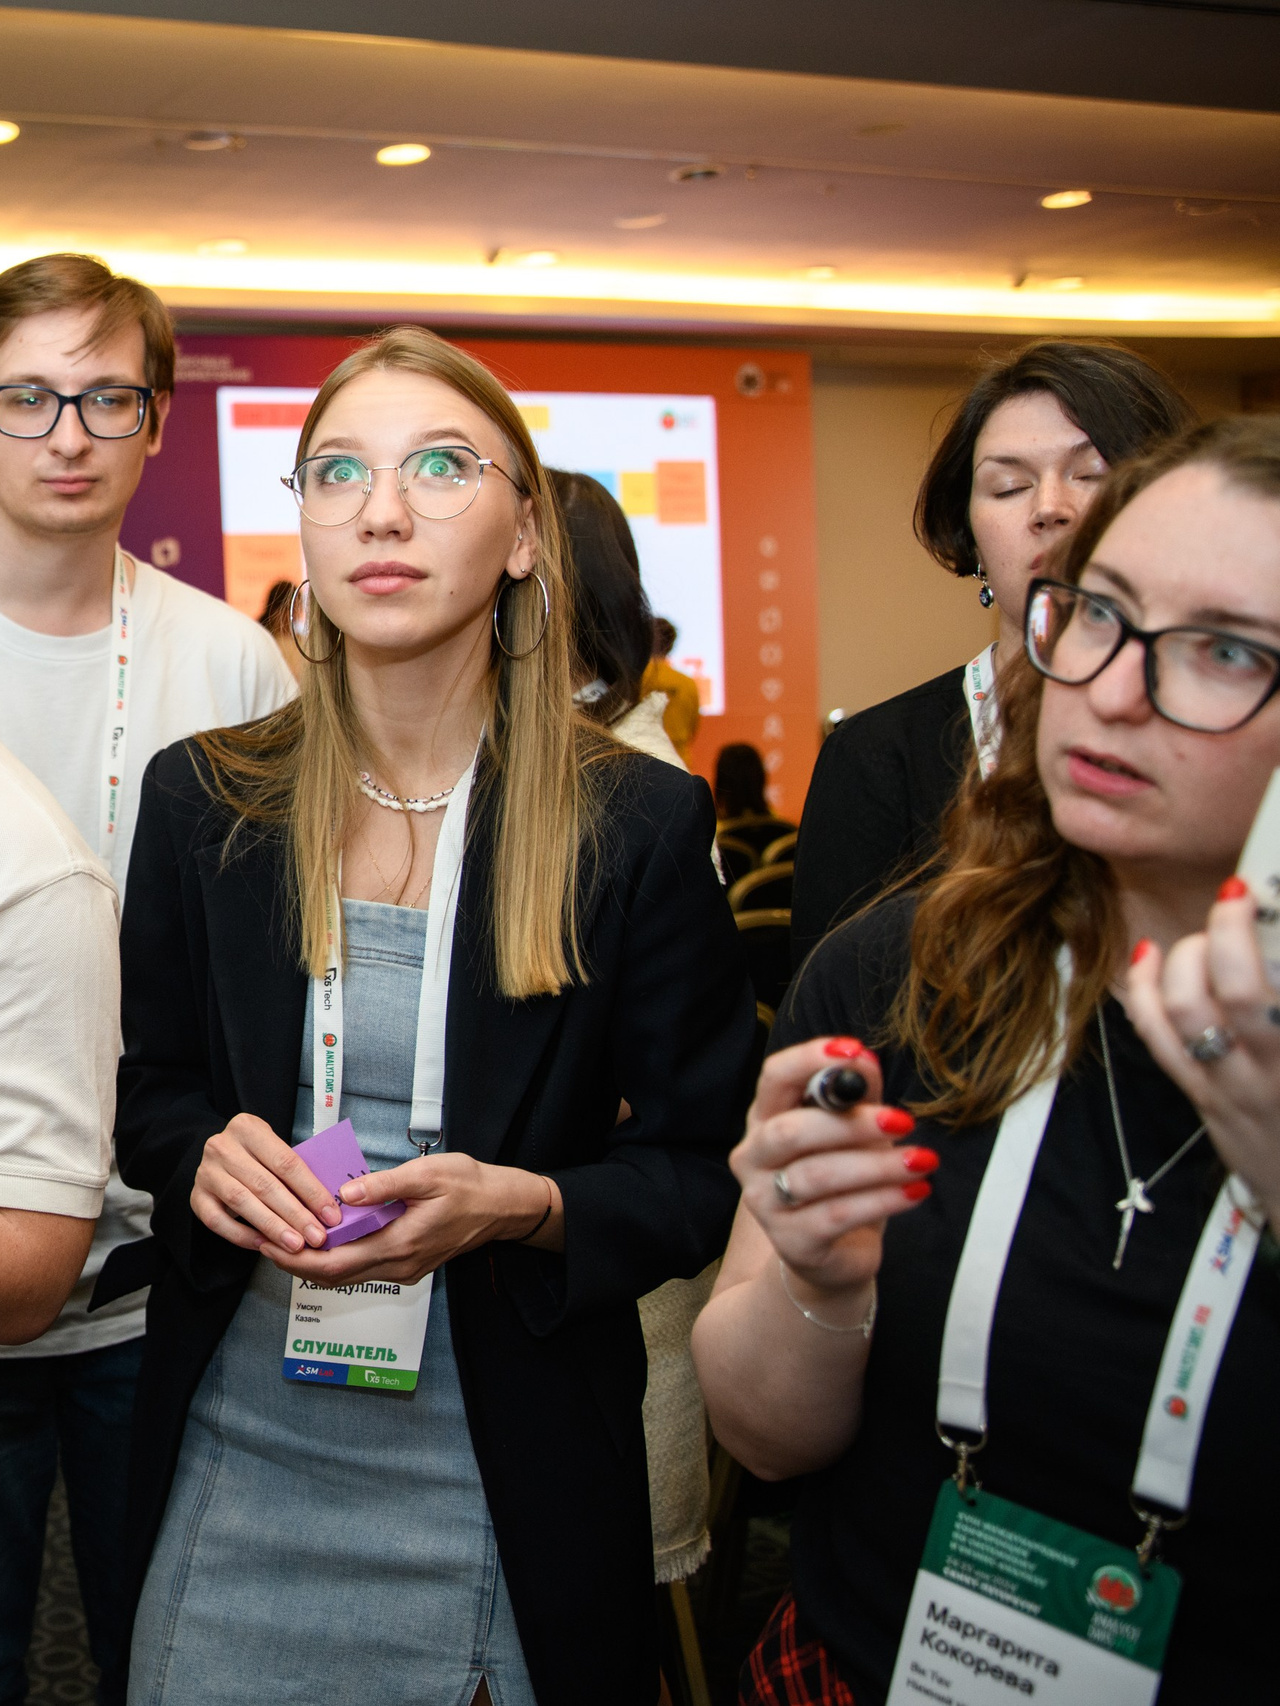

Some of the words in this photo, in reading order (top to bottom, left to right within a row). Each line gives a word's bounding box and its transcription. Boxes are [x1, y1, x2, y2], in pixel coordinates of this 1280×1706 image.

[323, 989, 333, 1011] Tech
[325, 1050, 335, 1079] ANALYST
[325, 1079, 334, 1093] DAYS
[325, 1095, 334, 1108] #18
[296, 1302, 323, 1313] Умскул
[294, 1314, 321, 1324] Казань
[292, 1339, 398, 1362] СЛУШАТЕЛЬ
[381, 1376, 401, 1387] Tech
[926, 1600, 1061, 1678] Маргарита
[919, 1627, 1036, 1696] Кокорева
